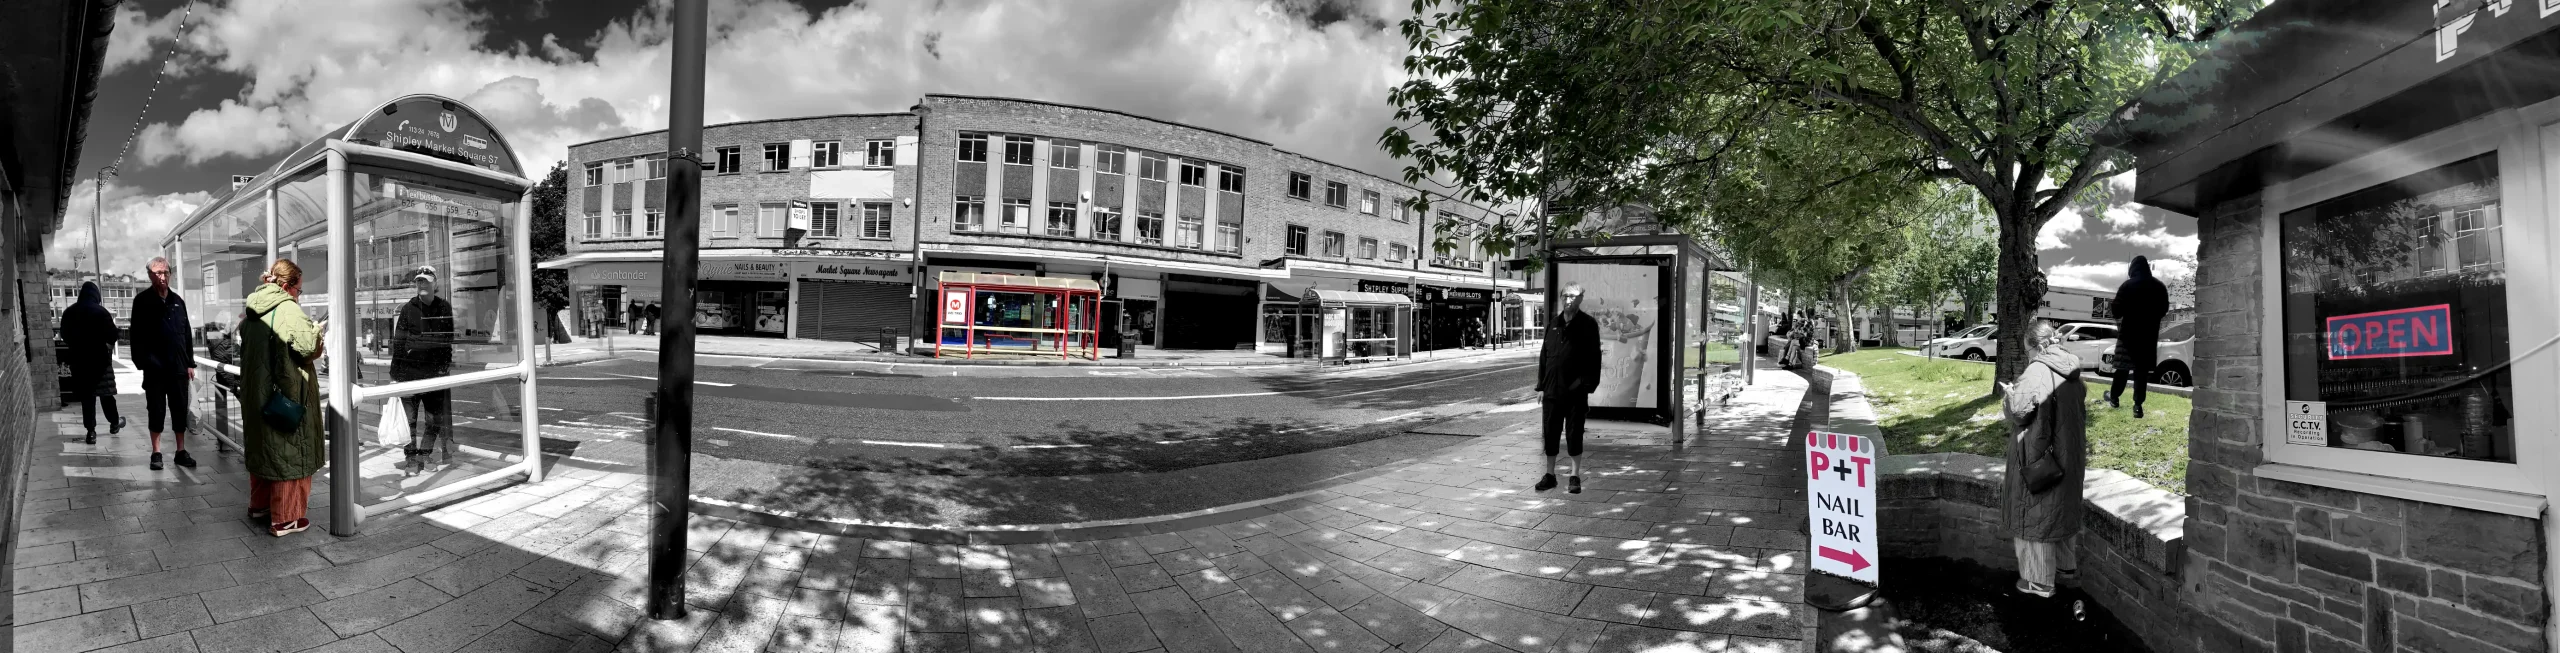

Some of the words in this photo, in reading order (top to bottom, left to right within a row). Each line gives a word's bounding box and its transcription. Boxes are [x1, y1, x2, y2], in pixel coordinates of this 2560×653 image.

[386, 131, 422, 149] Shipley
[425, 139, 455, 155] Market
[458, 147, 486, 162] Square
[488, 154, 498, 164] S7
[402, 199, 416, 208] 626
[424, 202, 438, 211] 656
[446, 206, 458, 214] 659
[602, 265, 648, 280] Santander
[816, 264, 838, 274] Market
[840, 265, 860, 277] Square
[862, 266, 899, 278] Newsagents
[1364, 284, 1389, 294] SHIPLEY
[2338, 315, 2438, 352] OPEN
[2292, 420, 2321, 430] C.C.T.V.
[1817, 492, 1864, 518] NAIL
[1822, 518, 1861, 543] BAR
